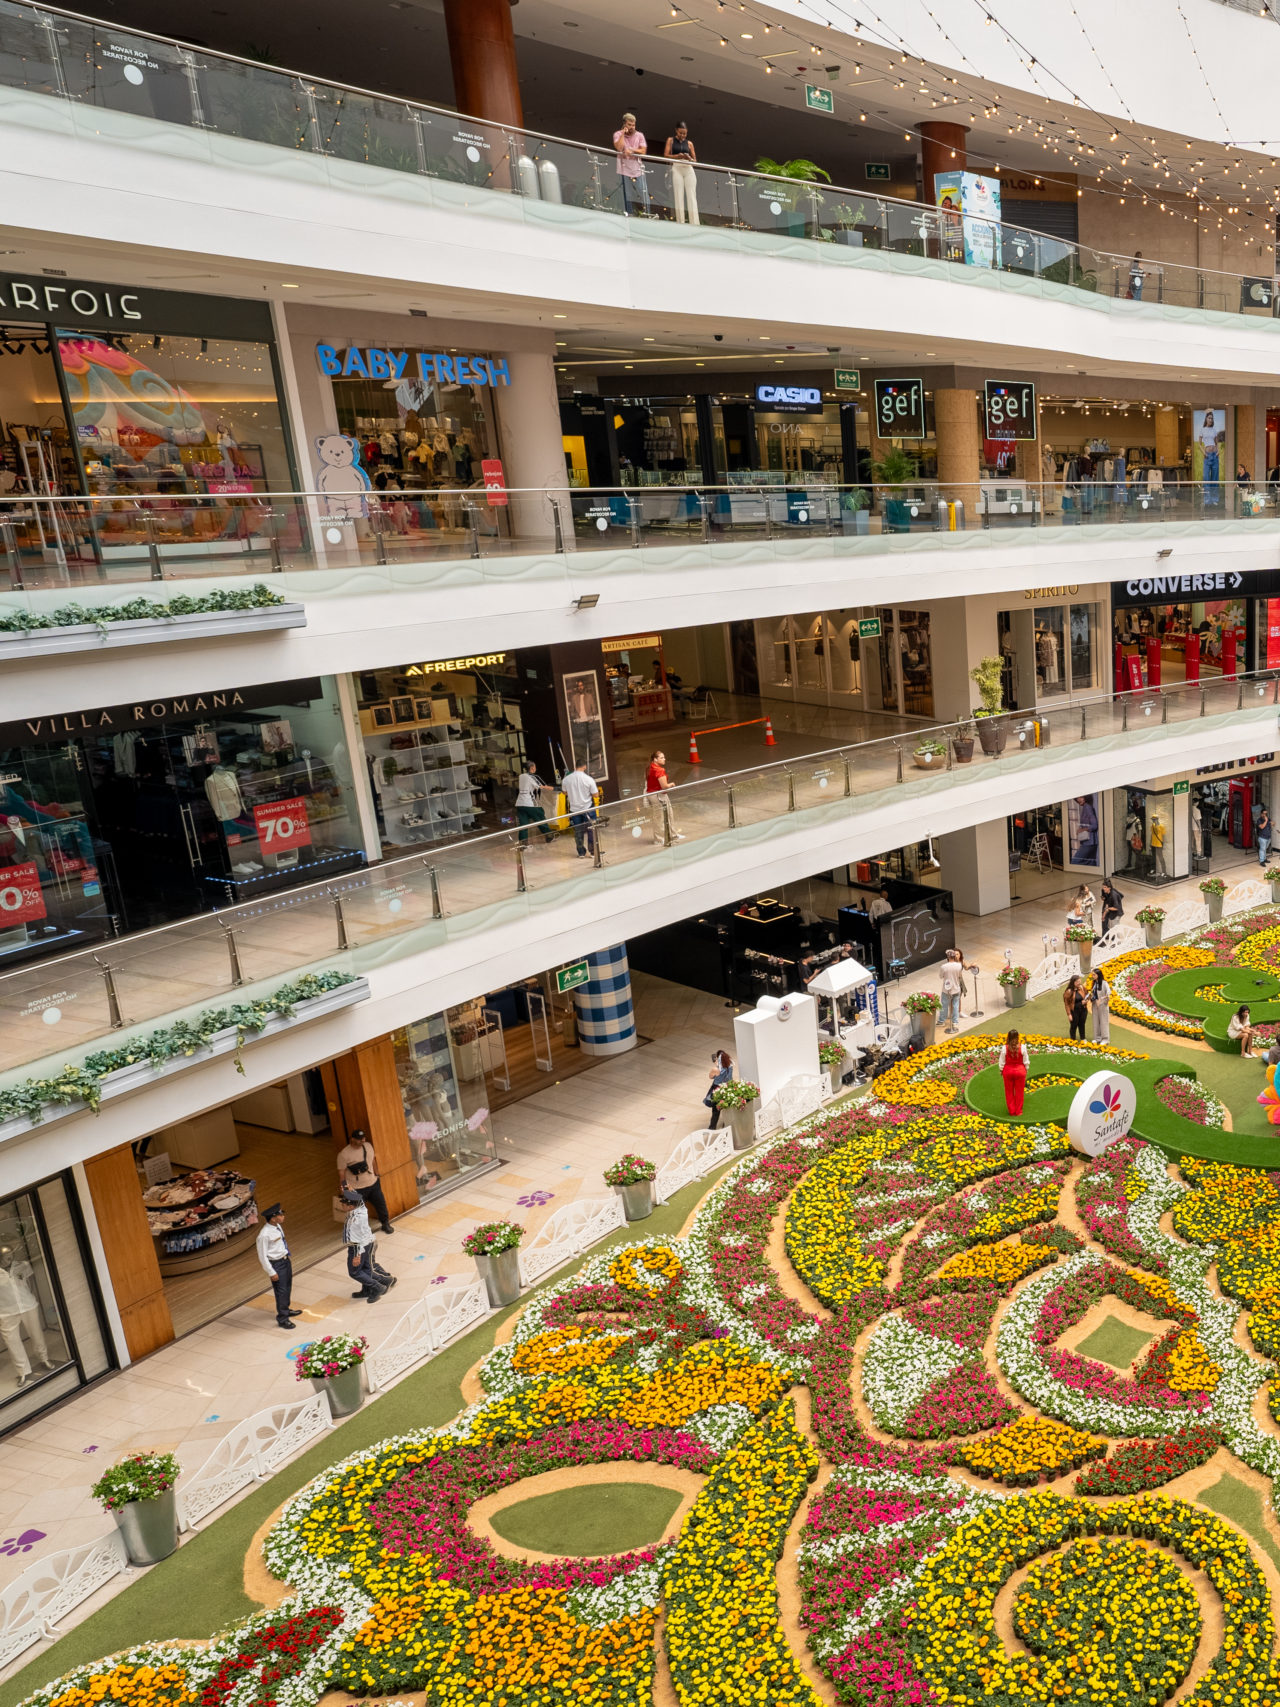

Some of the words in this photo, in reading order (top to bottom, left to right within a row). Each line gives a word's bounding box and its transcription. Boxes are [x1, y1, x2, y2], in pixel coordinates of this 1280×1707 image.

[0, 282, 142, 320] RFOIS
[316, 344, 409, 380] BABY
[416, 352, 512, 388] FRESH
[757, 385, 822, 404] CASIO
[881, 384, 919, 424] gef
[990, 388, 1031, 425] gef
[1126, 573, 1226, 596] CONVERSE
[603, 641, 631, 650] ARTISAN
[424, 653, 506, 674] FREEPORT
[26, 711, 114, 737] VILLA
[133, 691, 245, 721] ROMANA
[256, 805, 286, 816] SUMMER
[286, 801, 303, 810] SALE
[258, 816, 307, 843] 70%
[13, 868, 36, 879] SALE
[1093, 1108, 1130, 1142] Santafé
